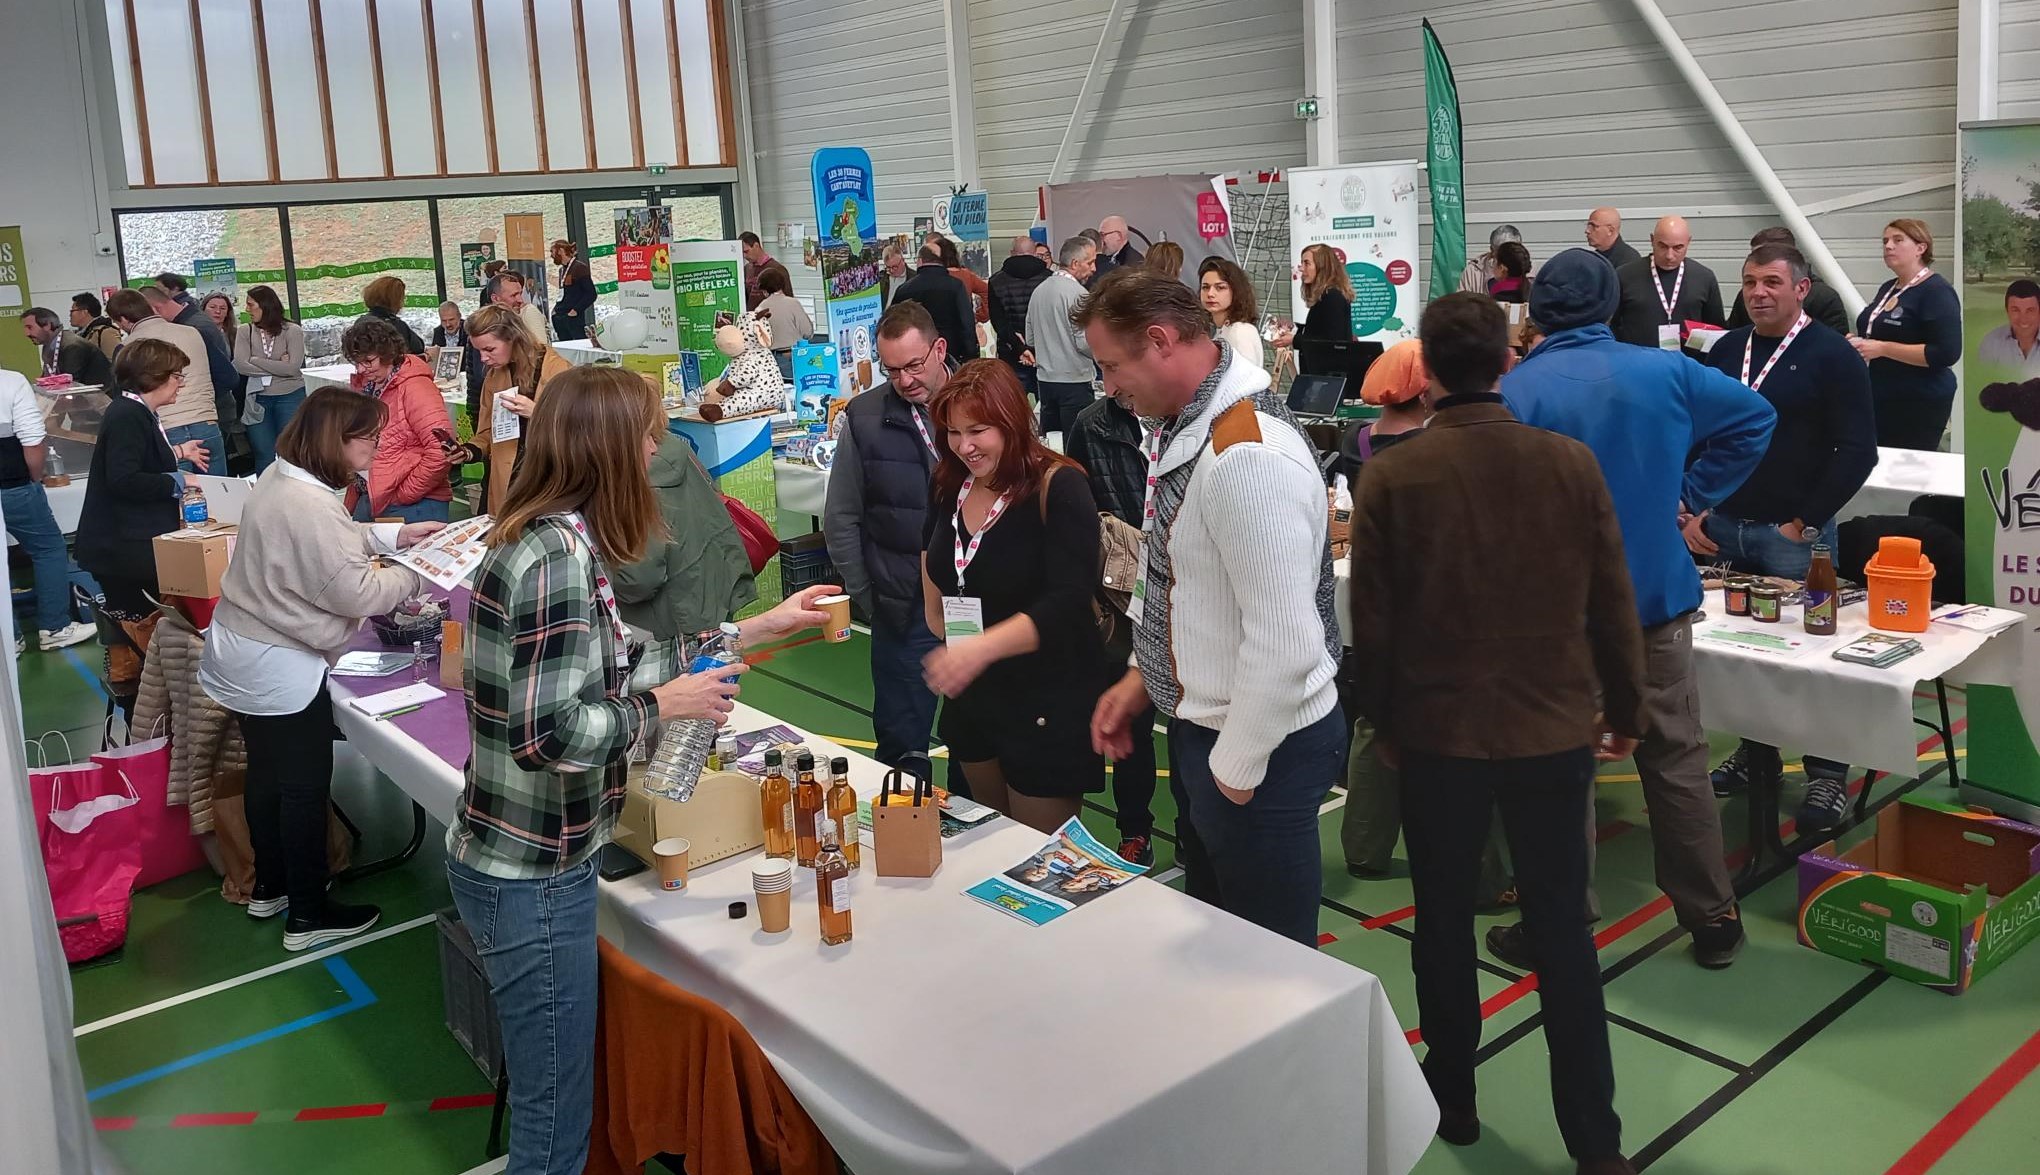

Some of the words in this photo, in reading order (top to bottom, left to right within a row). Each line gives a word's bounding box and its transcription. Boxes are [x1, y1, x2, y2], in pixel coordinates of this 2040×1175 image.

[953, 201, 962, 213] LA
[963, 200, 985, 212] FERME
[953, 214, 963, 226] DU
[965, 212, 986, 225] PILOU
[622, 251, 643, 263] BOOSTEZ
[695, 278, 737, 291] RÉFLEXE
[2002, 554, 2029, 574] LE
